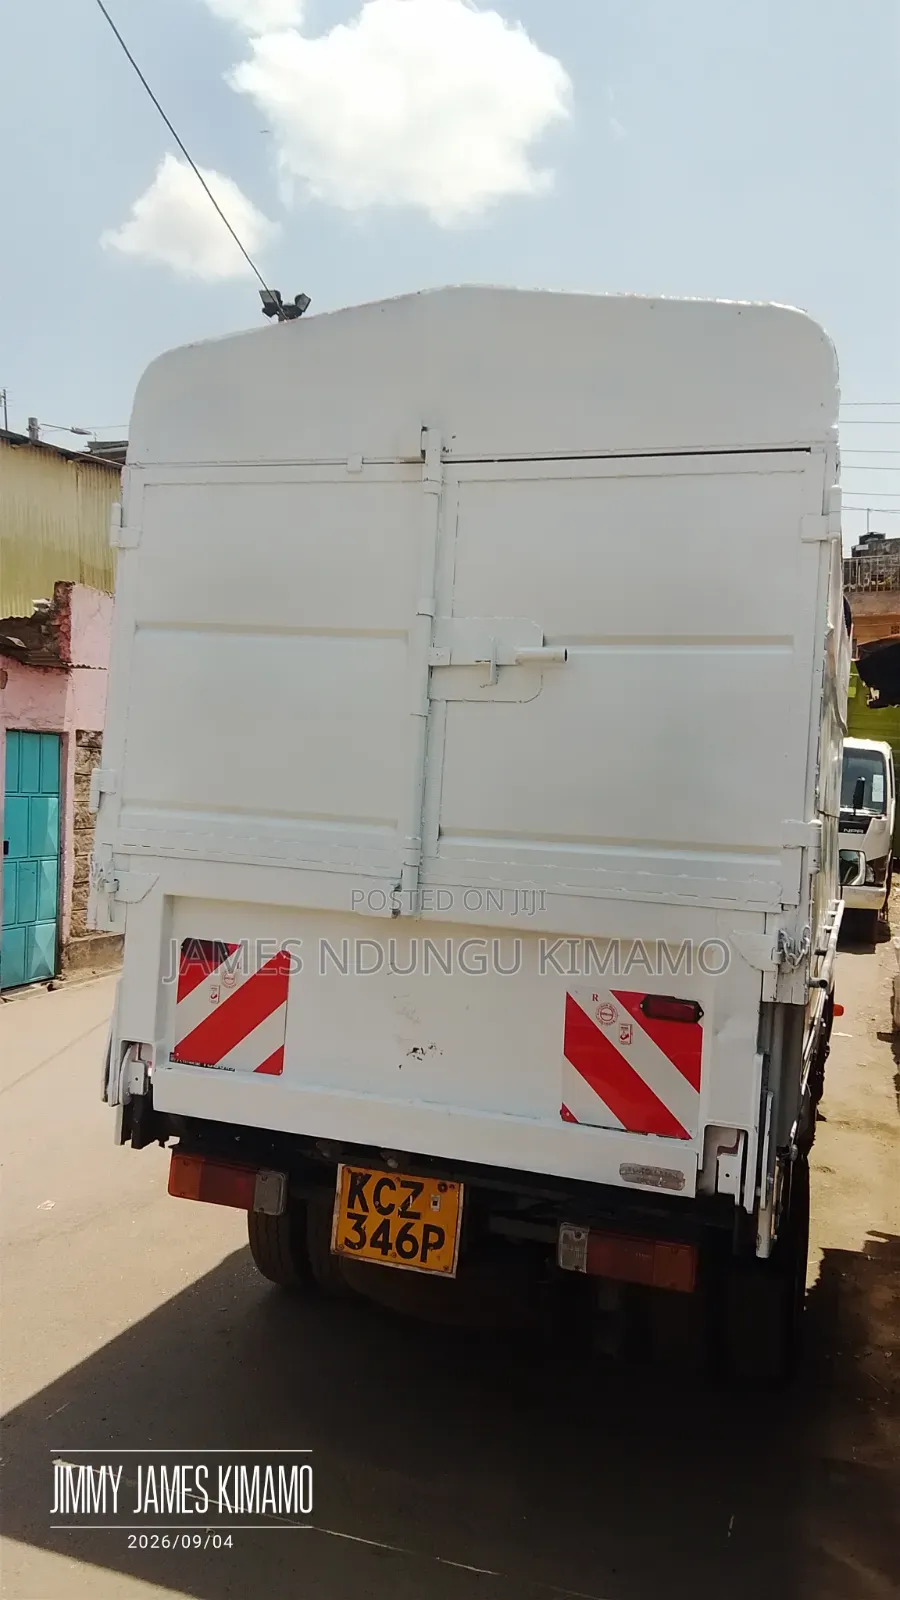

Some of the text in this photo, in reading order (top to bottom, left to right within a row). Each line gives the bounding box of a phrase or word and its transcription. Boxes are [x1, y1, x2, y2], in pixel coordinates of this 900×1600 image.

[592, 993, 599, 1002] R
[346, 1172, 424, 1220] KCZ
[344, 1212, 445, 1263] 346P
